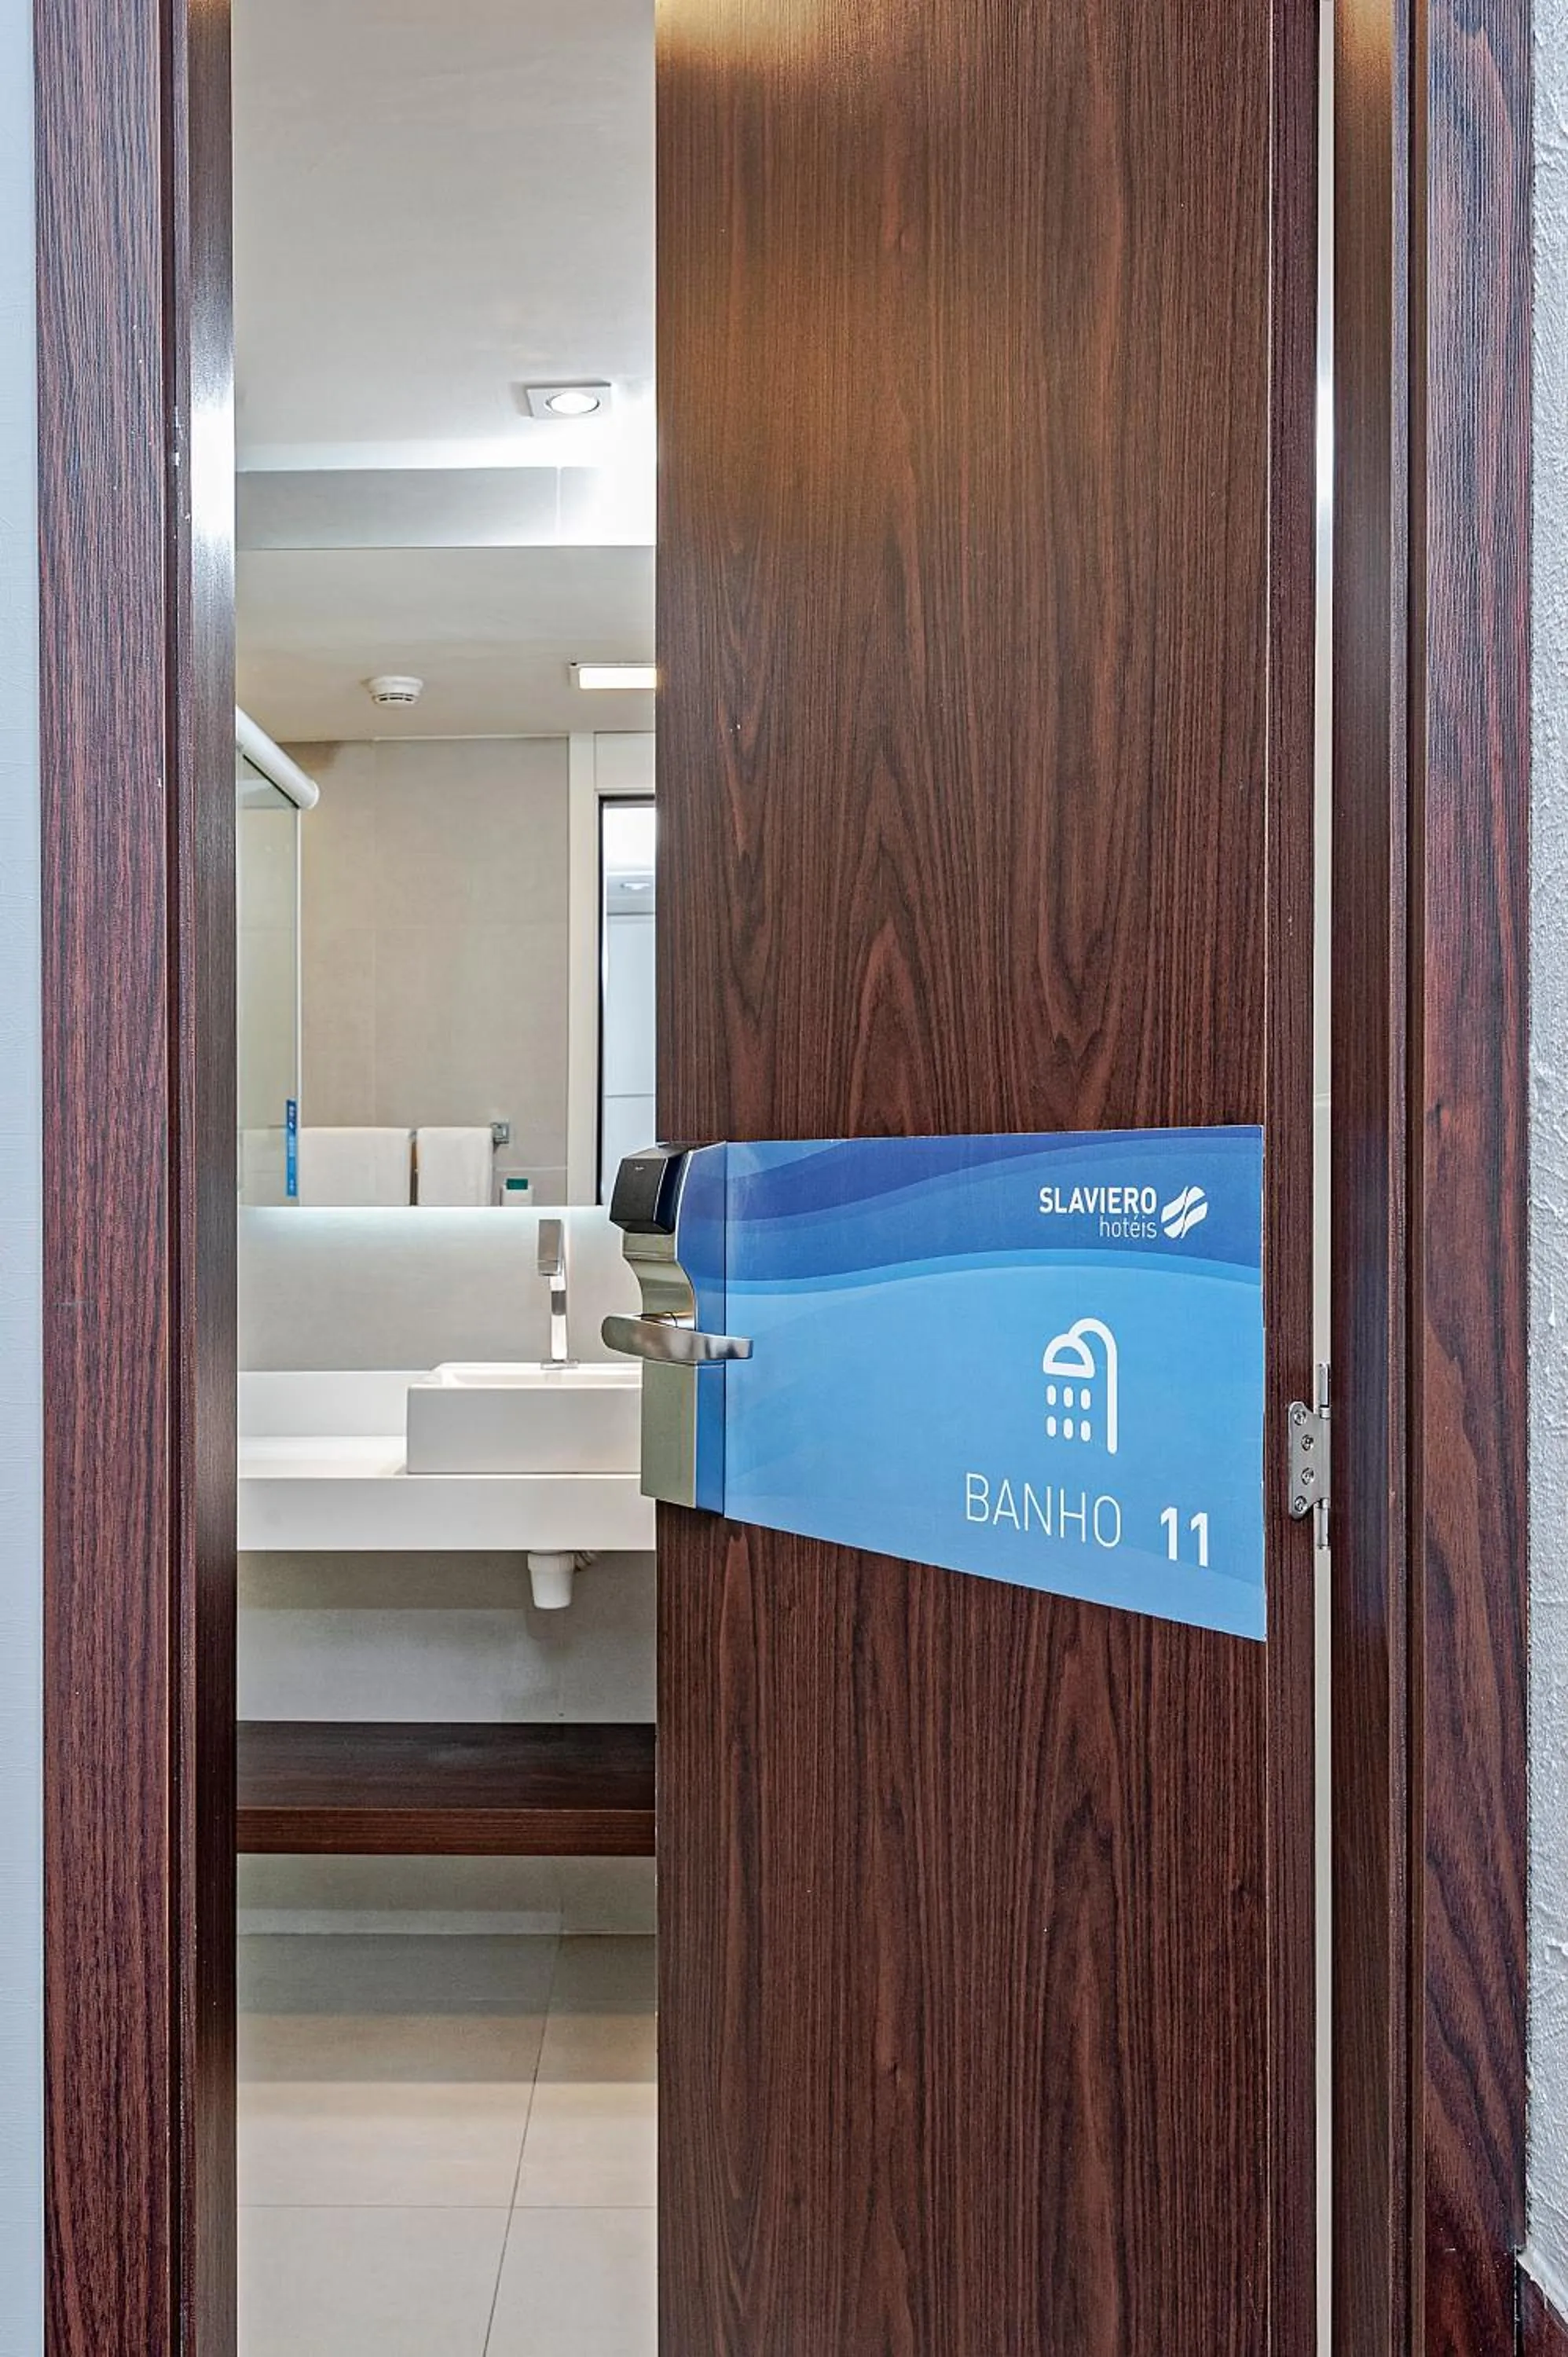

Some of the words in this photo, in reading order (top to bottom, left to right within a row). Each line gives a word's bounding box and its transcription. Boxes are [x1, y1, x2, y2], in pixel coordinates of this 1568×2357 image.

[1039, 1186, 1157, 1214] SLAVIERO
[1100, 1214, 1157, 1239] hotéis
[965, 1472, 1122, 1548] BANHO
[1160, 1507, 1209, 1567] 11
